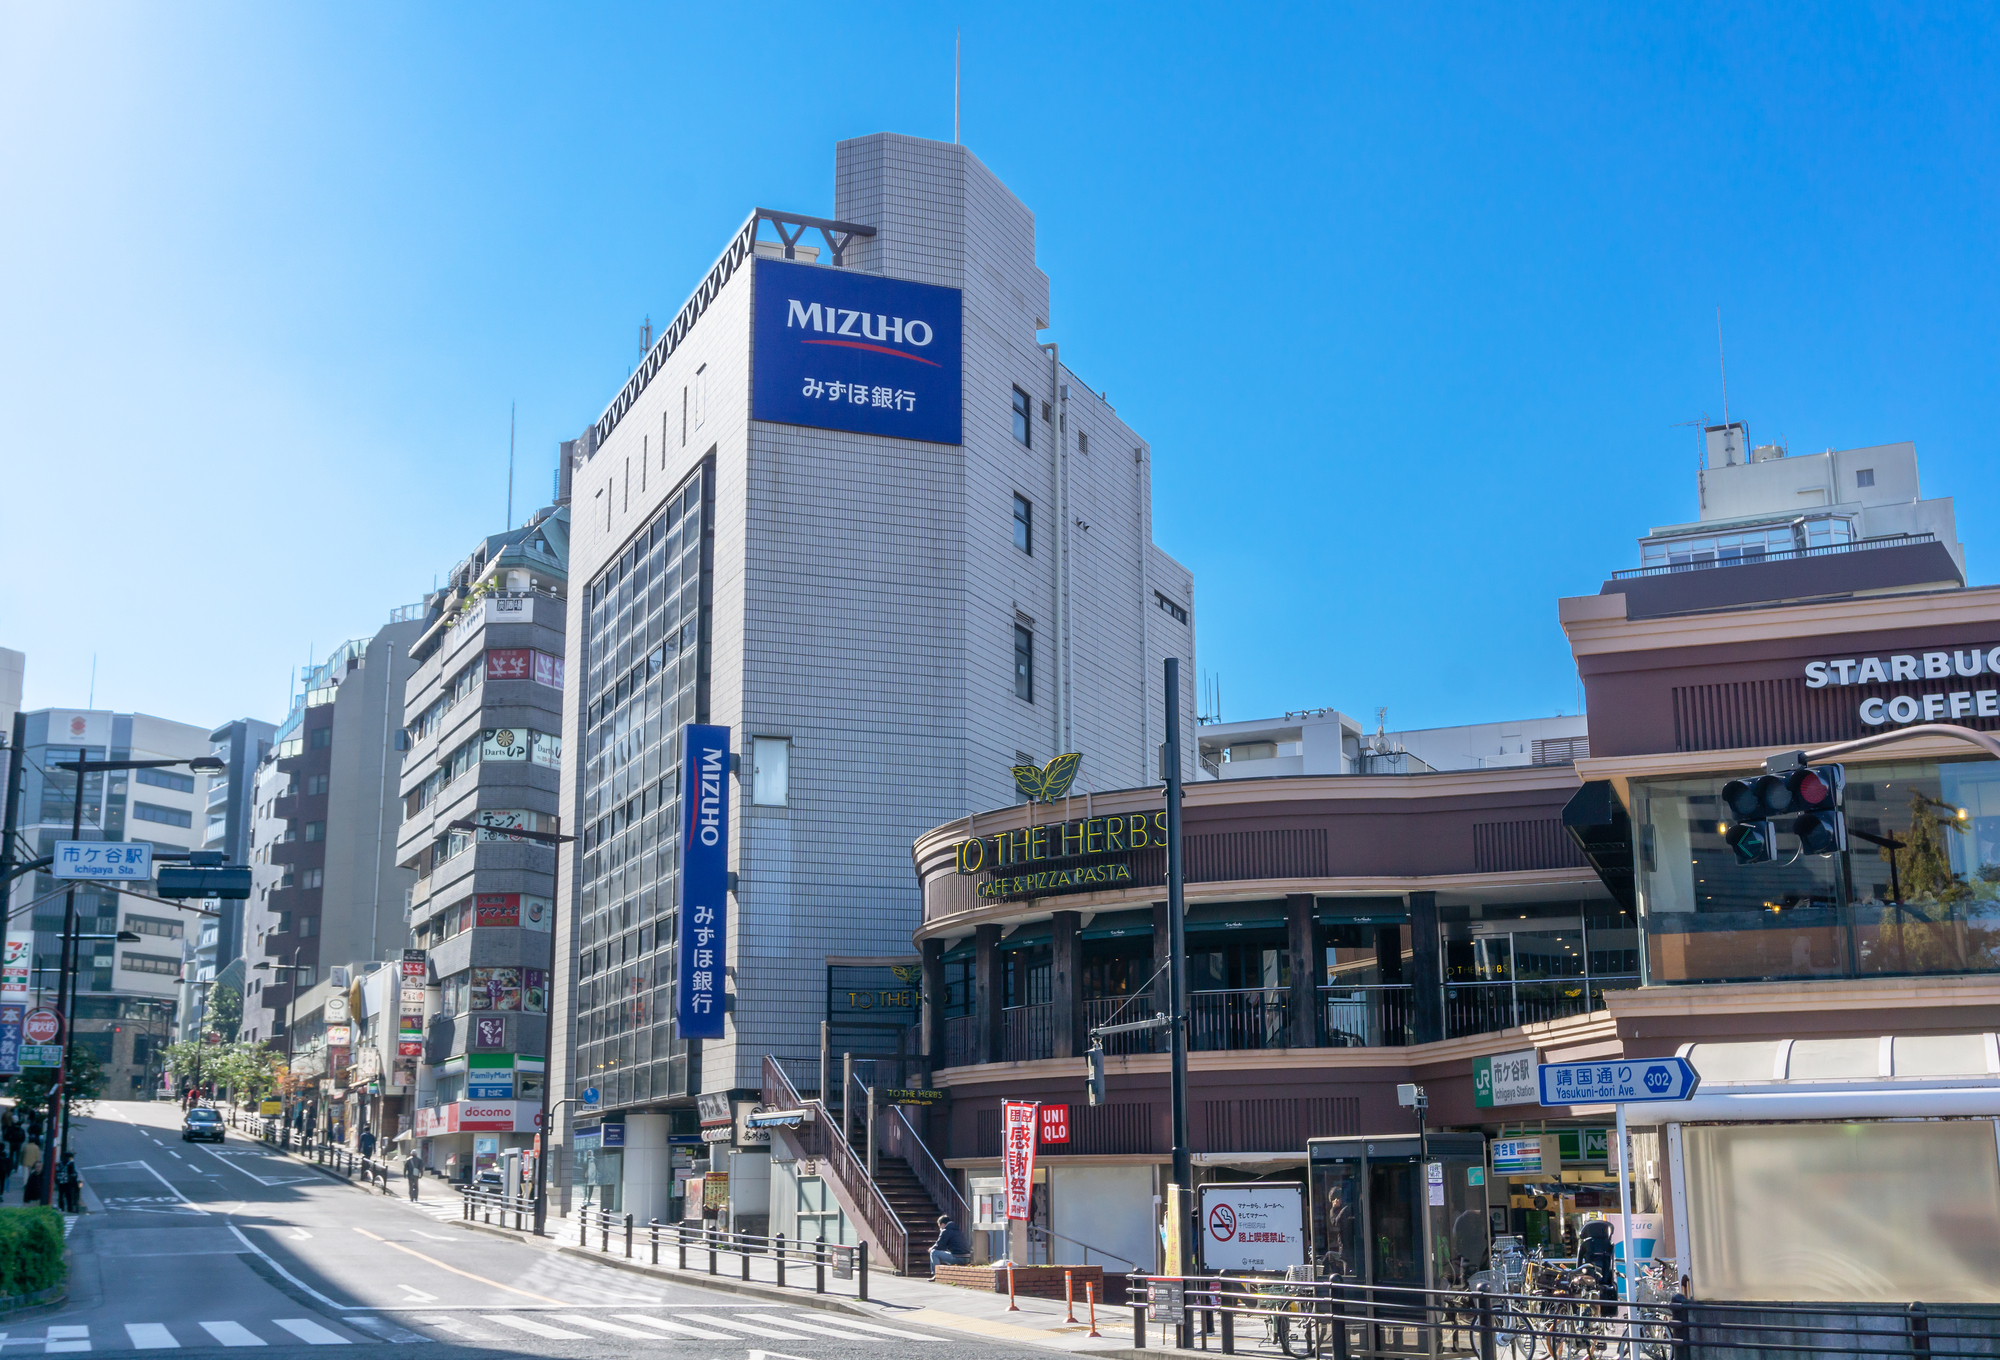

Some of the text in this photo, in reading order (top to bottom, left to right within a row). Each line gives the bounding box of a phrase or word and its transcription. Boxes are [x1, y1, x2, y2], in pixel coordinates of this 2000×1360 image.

[787, 299, 933, 346] MIZUHO
[802, 377, 916, 412] みずほ銀行
[485, 746, 525, 758] Darts UP
[701, 747, 722, 846] MIZUHO
[953, 811, 1168, 875] TO THE HERBS
[74, 865, 136, 876] Ichigaya Sta.
[976, 864, 1130, 898] CAFE & PIZZA PASTA
[692, 905, 715, 1014] みずほ銀行
[848, 992, 873, 1009] TO
[879, 991, 909, 1007] THE
[3, 1009, 19, 1022] 本
[470, 1072, 511, 1080] FamilyMart
[1476, 1069, 1490, 1089] JR
[1556, 1066, 1632, 1086] 靖国通り
[1647, 1073, 1669, 1087] 302
[487, 1089, 503, 1097] たばこ
[887, 1089, 942, 1099] TO THE HERBS
[1495, 1085, 1535, 1101] Ichigaya Station
[1556, 1085, 1636, 1099] Yasukuni-dori Ave.
[465, 1106, 511, 1117] docomo
[1043, 1109, 1063, 1123] UNI
[1044, 1125, 1066, 1141] QLO
[1009, 1125, 1031, 1203] 感謝祭
